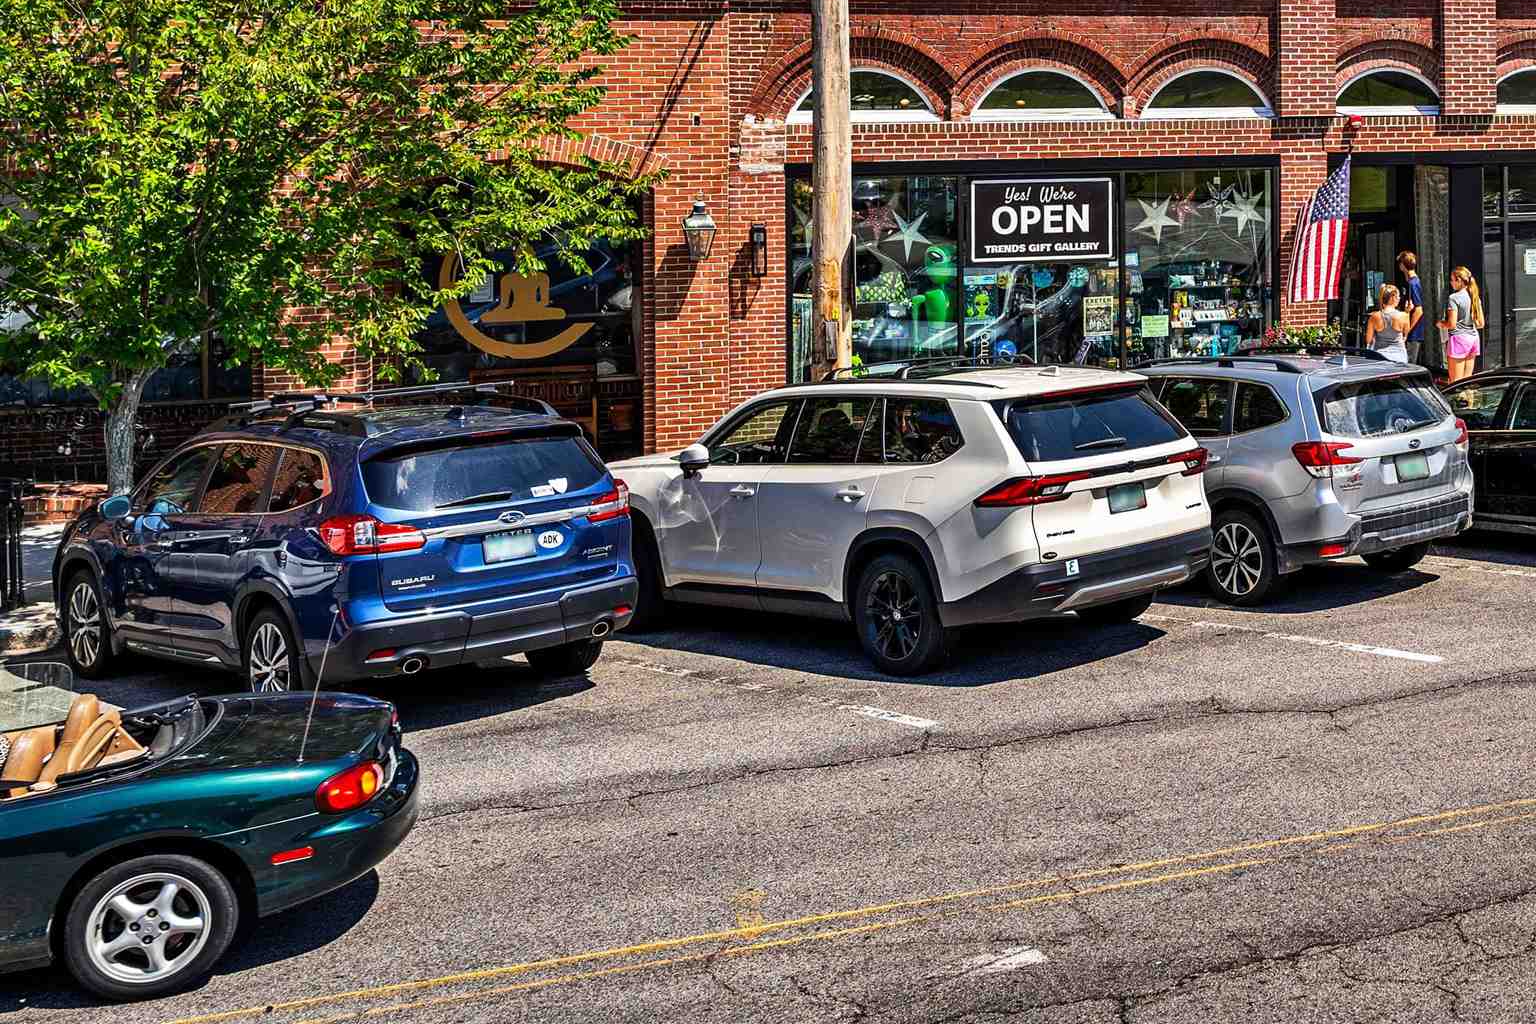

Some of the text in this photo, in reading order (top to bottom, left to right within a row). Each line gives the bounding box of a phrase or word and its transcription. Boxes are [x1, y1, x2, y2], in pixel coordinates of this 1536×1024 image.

[1004, 186, 1077, 204] Yes! We're
[991, 204, 1090, 235] OPEN
[984, 242, 1100, 254] TRENDS GIFT GALLERY
[543, 534, 559, 544] ADK
[391, 574, 435, 586] SUBARU
